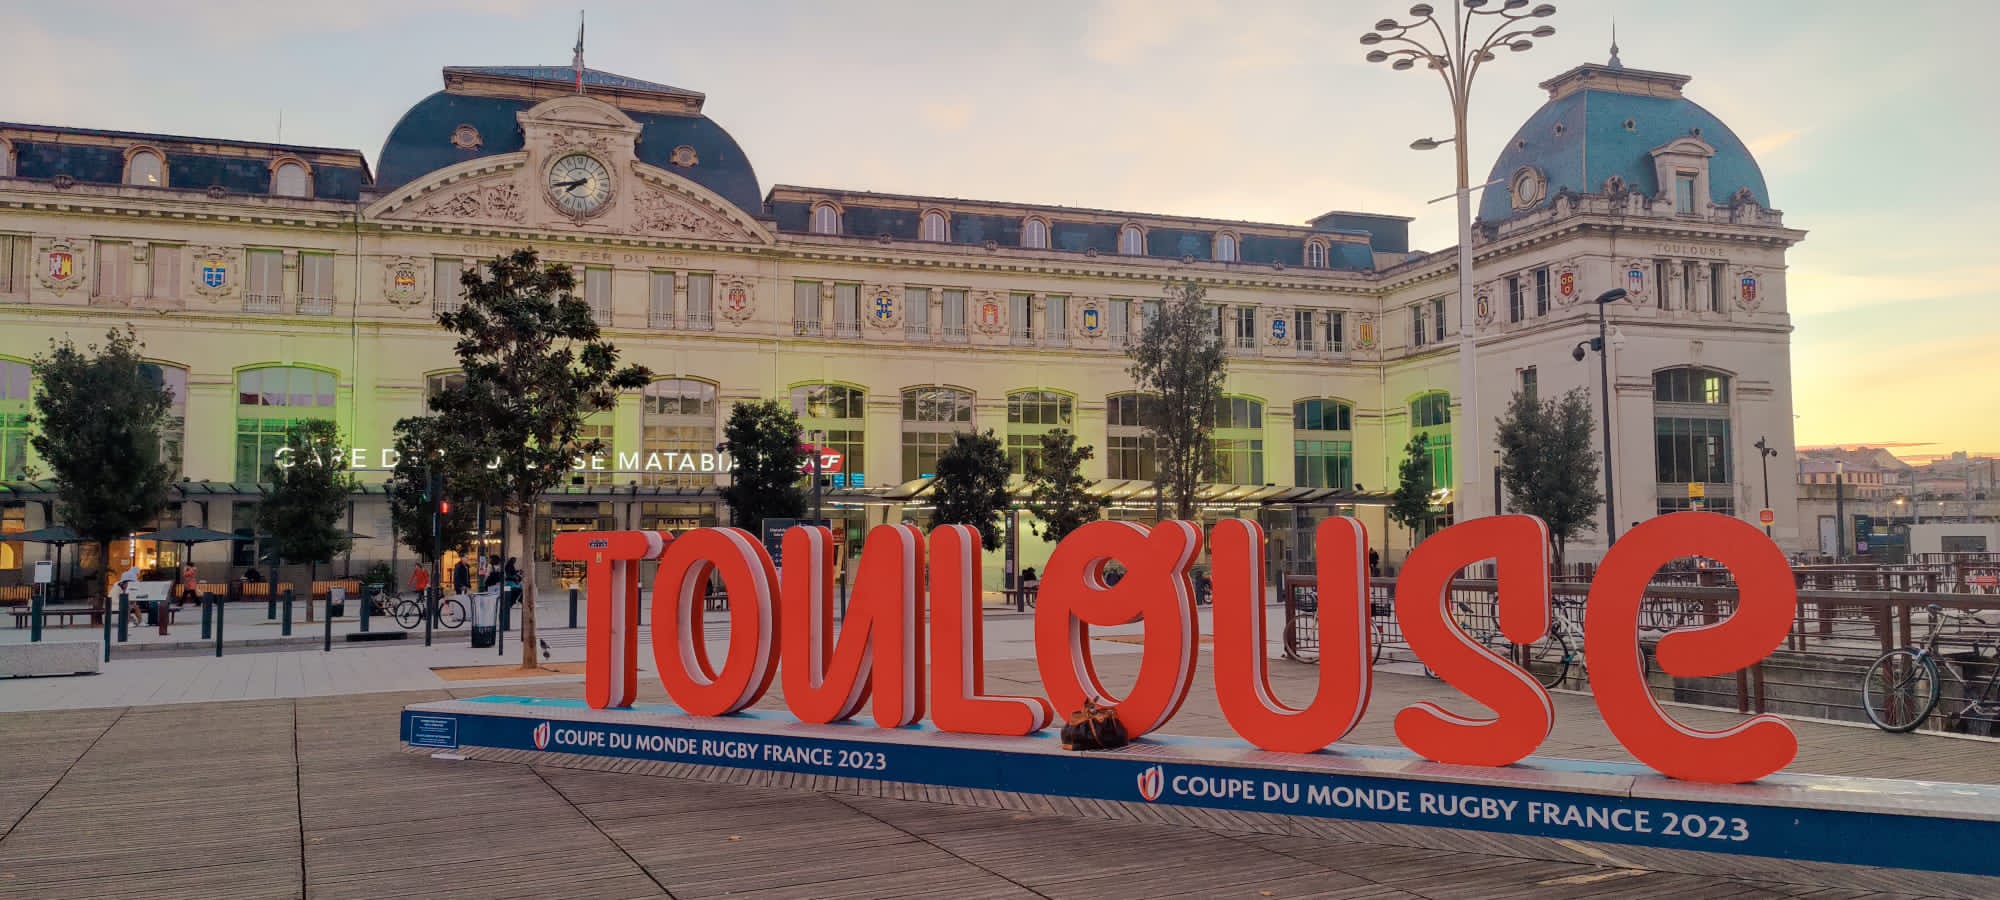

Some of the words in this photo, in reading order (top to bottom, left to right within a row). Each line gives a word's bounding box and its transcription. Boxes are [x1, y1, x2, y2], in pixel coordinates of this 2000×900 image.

[580, 250, 613, 262] FER
[624, 254, 646, 265] DU
[1656, 243, 1725, 257] TOULOUSE
[618, 451, 764, 472] MATABIA
[554, 728, 605, 748] COUPE
[609, 732, 632, 749] DU
[635, 735, 698, 755] MONDE
[701, 740, 760, 760] RUGBY
[763, 744, 833, 767] FRANCE
[838, 750, 887, 771] 2023
[1171, 775, 1257, 801] COUPE
[1263, 782, 1300, 804] DU
[1307, 784, 1412, 813] MONDE
[1419, 791, 1519, 822] RUGBY
[1528, 801, 1653, 834] FRANCE
[1661, 812, 1750, 842] 2023
